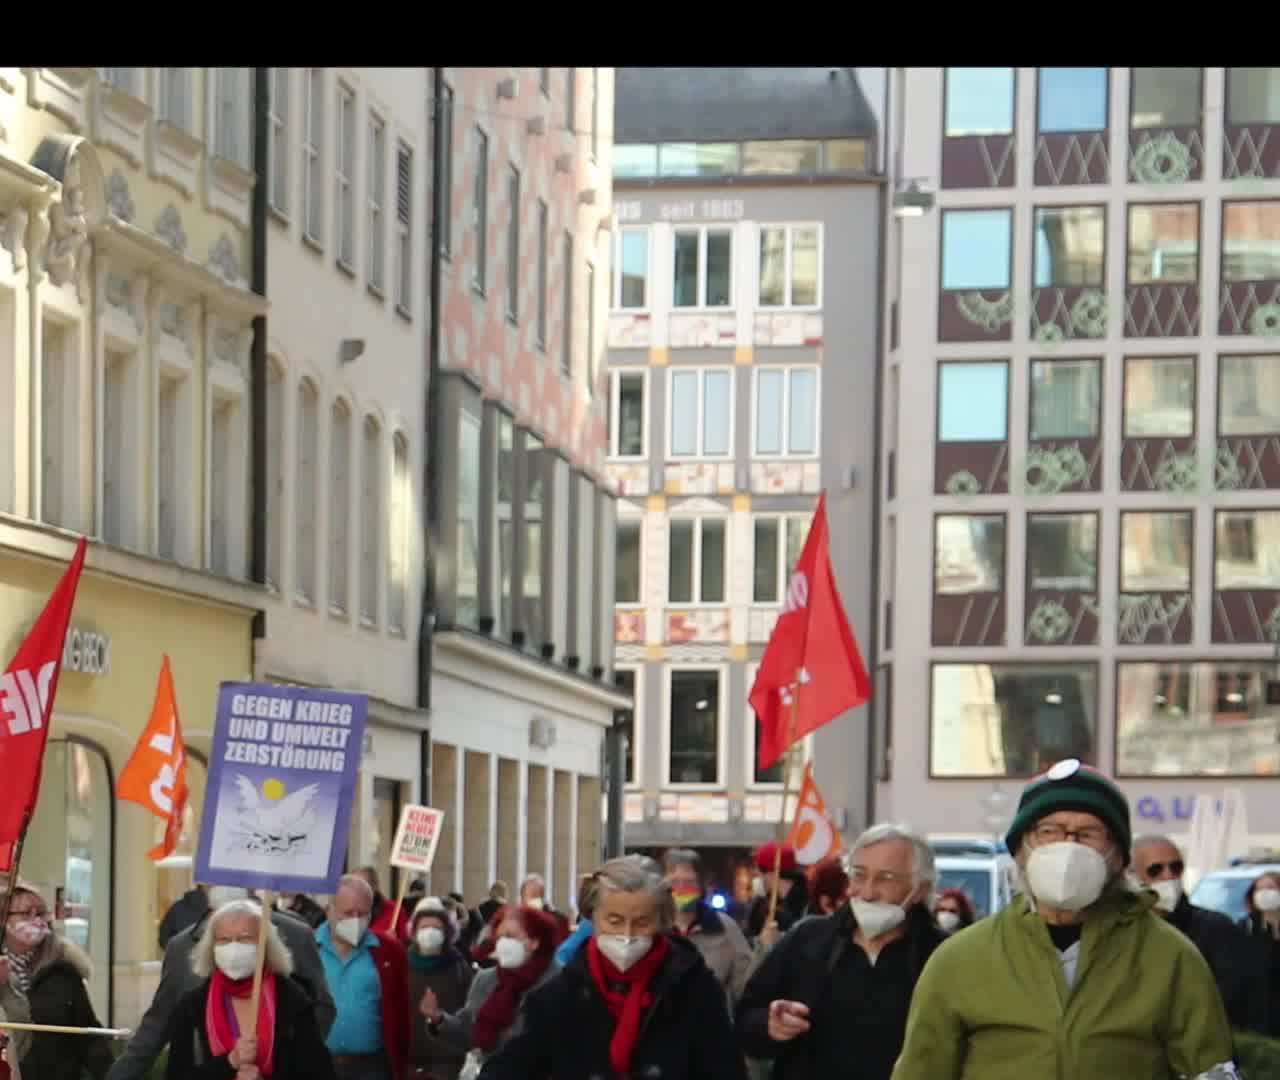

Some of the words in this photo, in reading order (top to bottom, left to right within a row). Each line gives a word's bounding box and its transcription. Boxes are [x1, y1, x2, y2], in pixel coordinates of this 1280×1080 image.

[232, 694, 293, 719] GEGEN
[295, 699, 353, 725] KRIEG
[228, 717, 269, 741] UND
[271, 721, 352, 749] UMWELT
[223, 741, 346, 772] ZERSTÖRUNG
